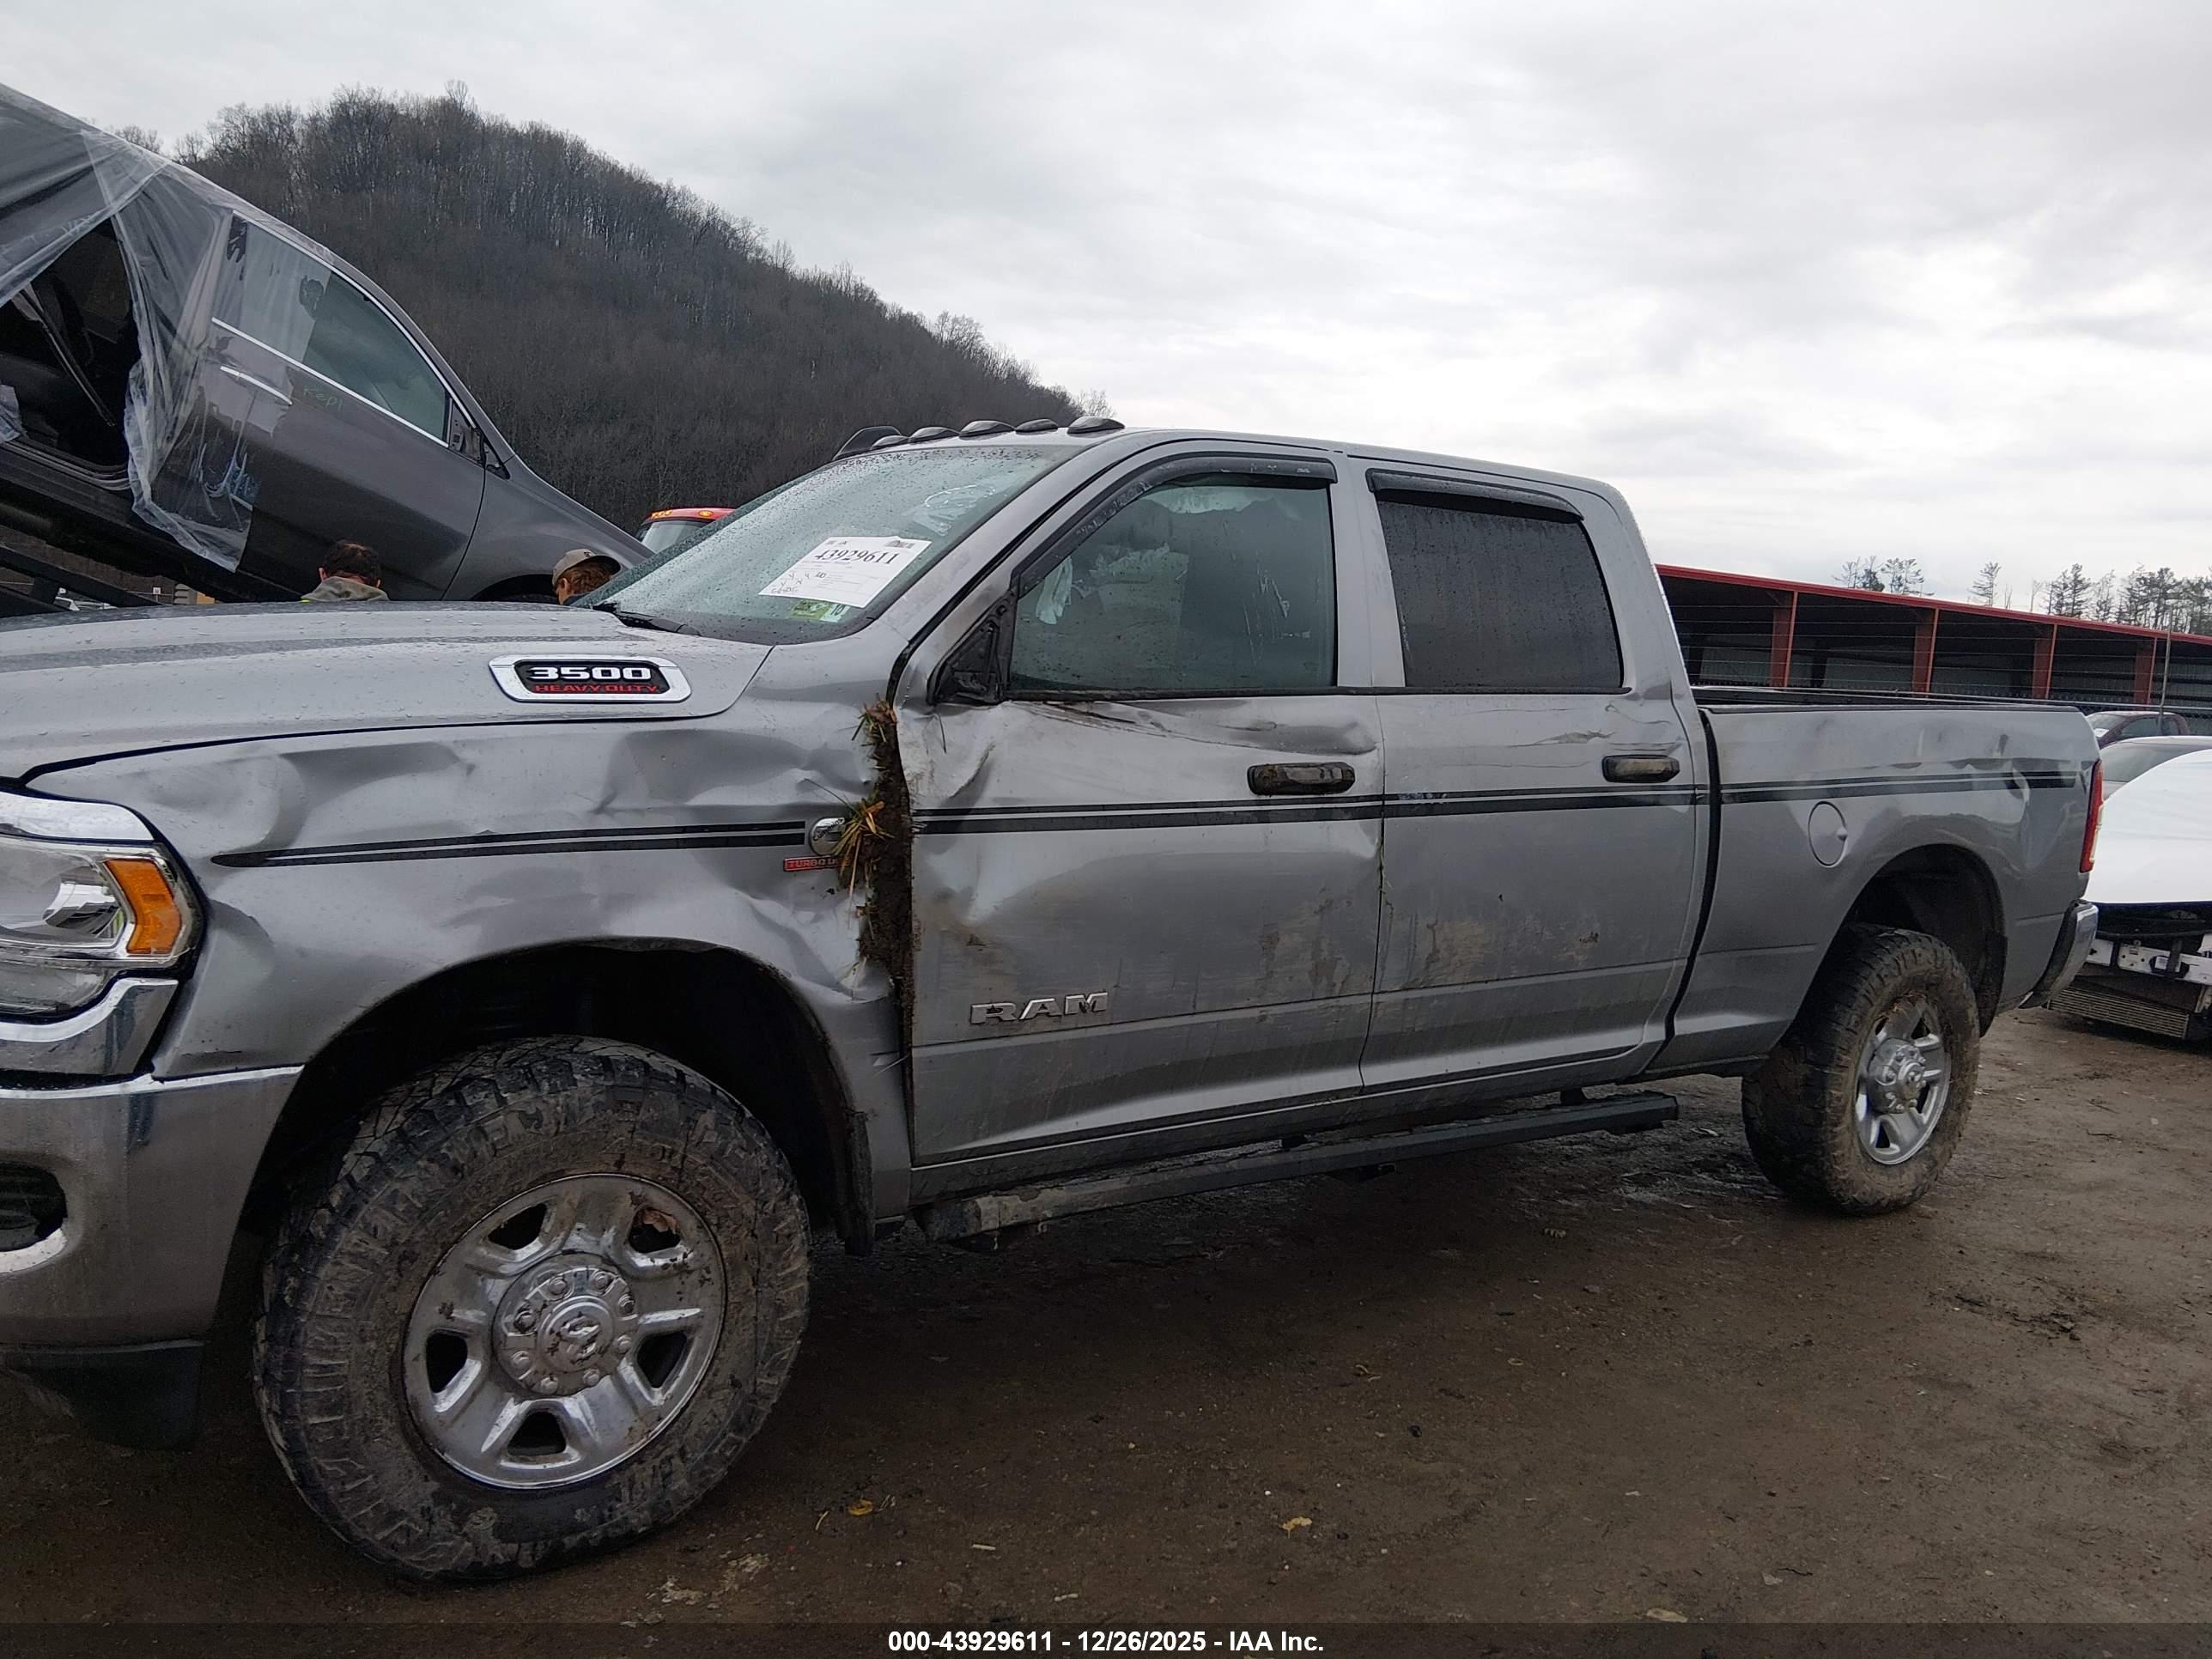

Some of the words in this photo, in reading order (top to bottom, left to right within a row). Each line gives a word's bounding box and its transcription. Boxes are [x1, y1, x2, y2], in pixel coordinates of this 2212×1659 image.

[815, 549, 900, 564] 43929611
[529, 666, 652, 681] 3500
[604, 684, 659, 693] DUTY
[970, 993, 1108, 1024] RAM
